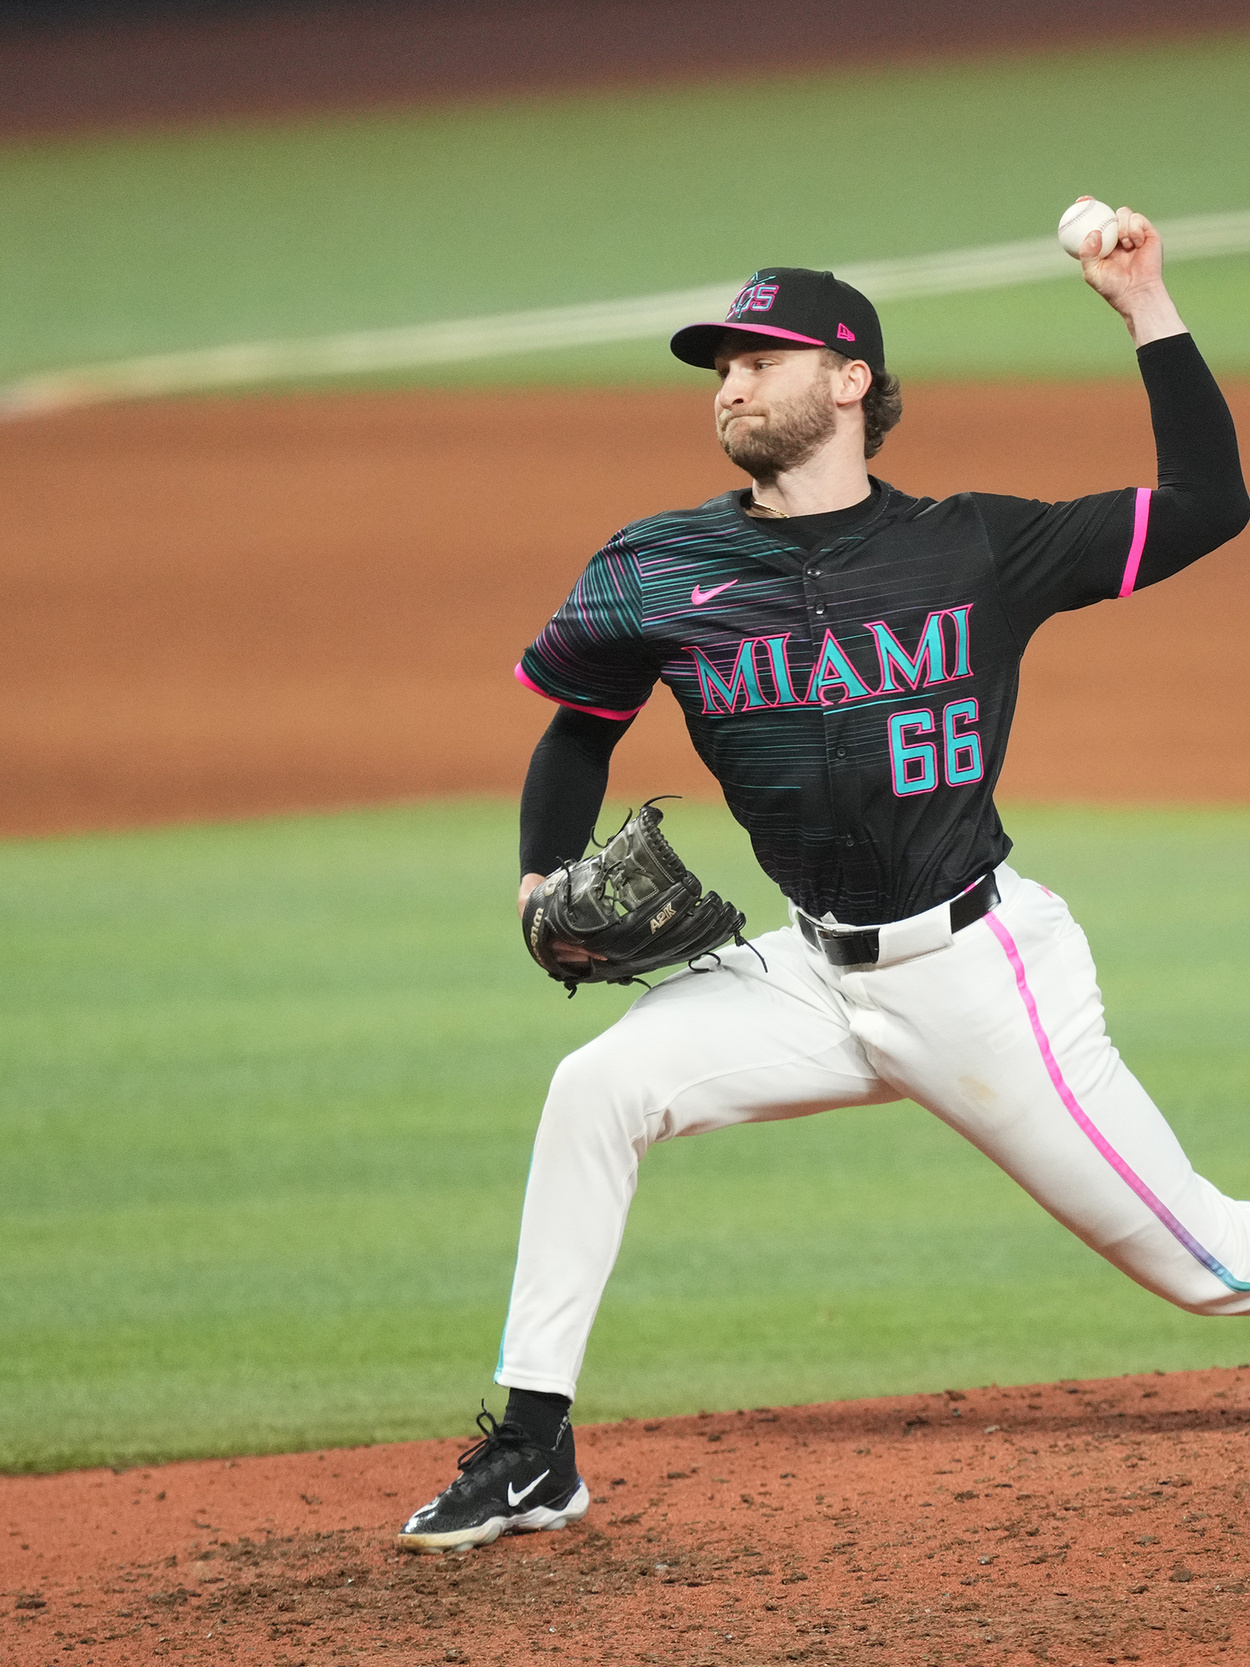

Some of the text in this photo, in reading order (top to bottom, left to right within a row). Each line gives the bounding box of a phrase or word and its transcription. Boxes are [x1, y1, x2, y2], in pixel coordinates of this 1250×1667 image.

[725, 281, 780, 322] 05
[682, 603, 974, 714] MIAMI
[888, 697, 984, 797] 66
[650, 902, 677, 935] A2K
